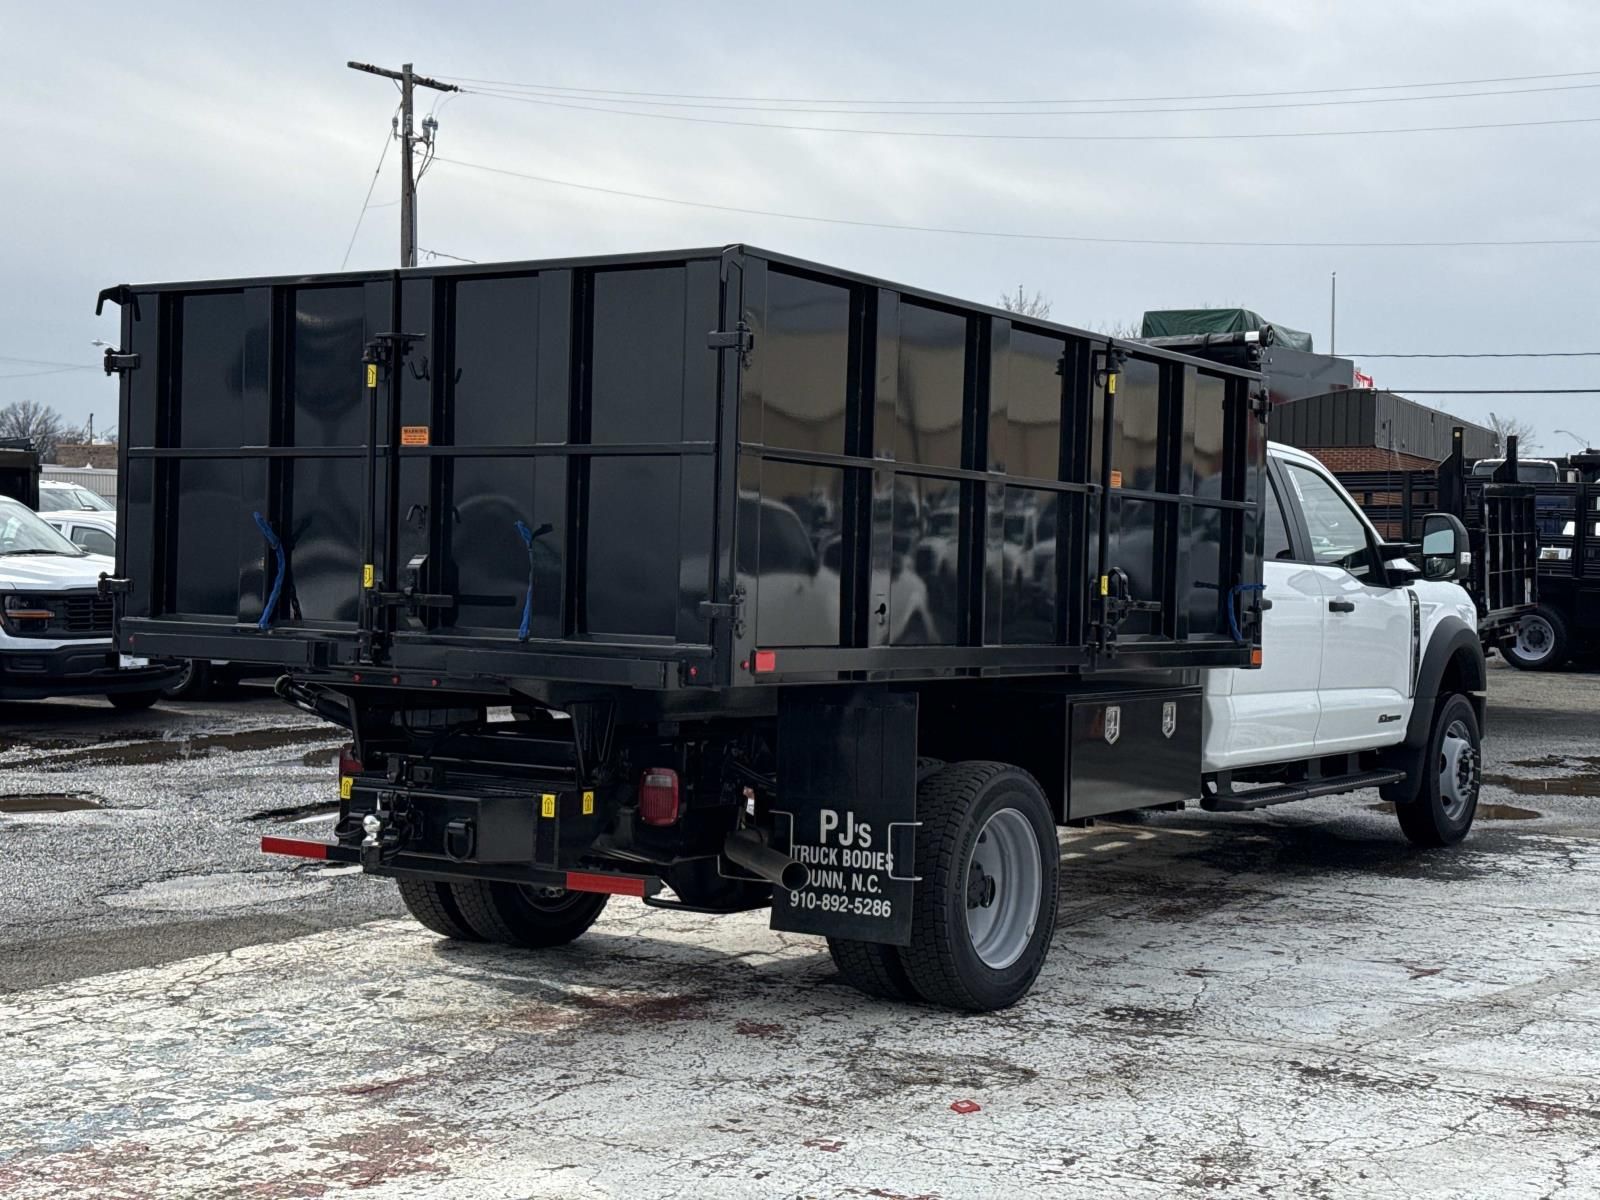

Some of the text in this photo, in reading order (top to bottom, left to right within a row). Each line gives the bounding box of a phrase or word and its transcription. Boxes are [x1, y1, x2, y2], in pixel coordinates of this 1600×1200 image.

[820, 809, 872, 848] PJ's
[792, 844, 893, 871] TRUCK BODIES
[807, 868, 882, 894] UNN, N.C.
[790, 890, 892, 917] 910-892-5286
